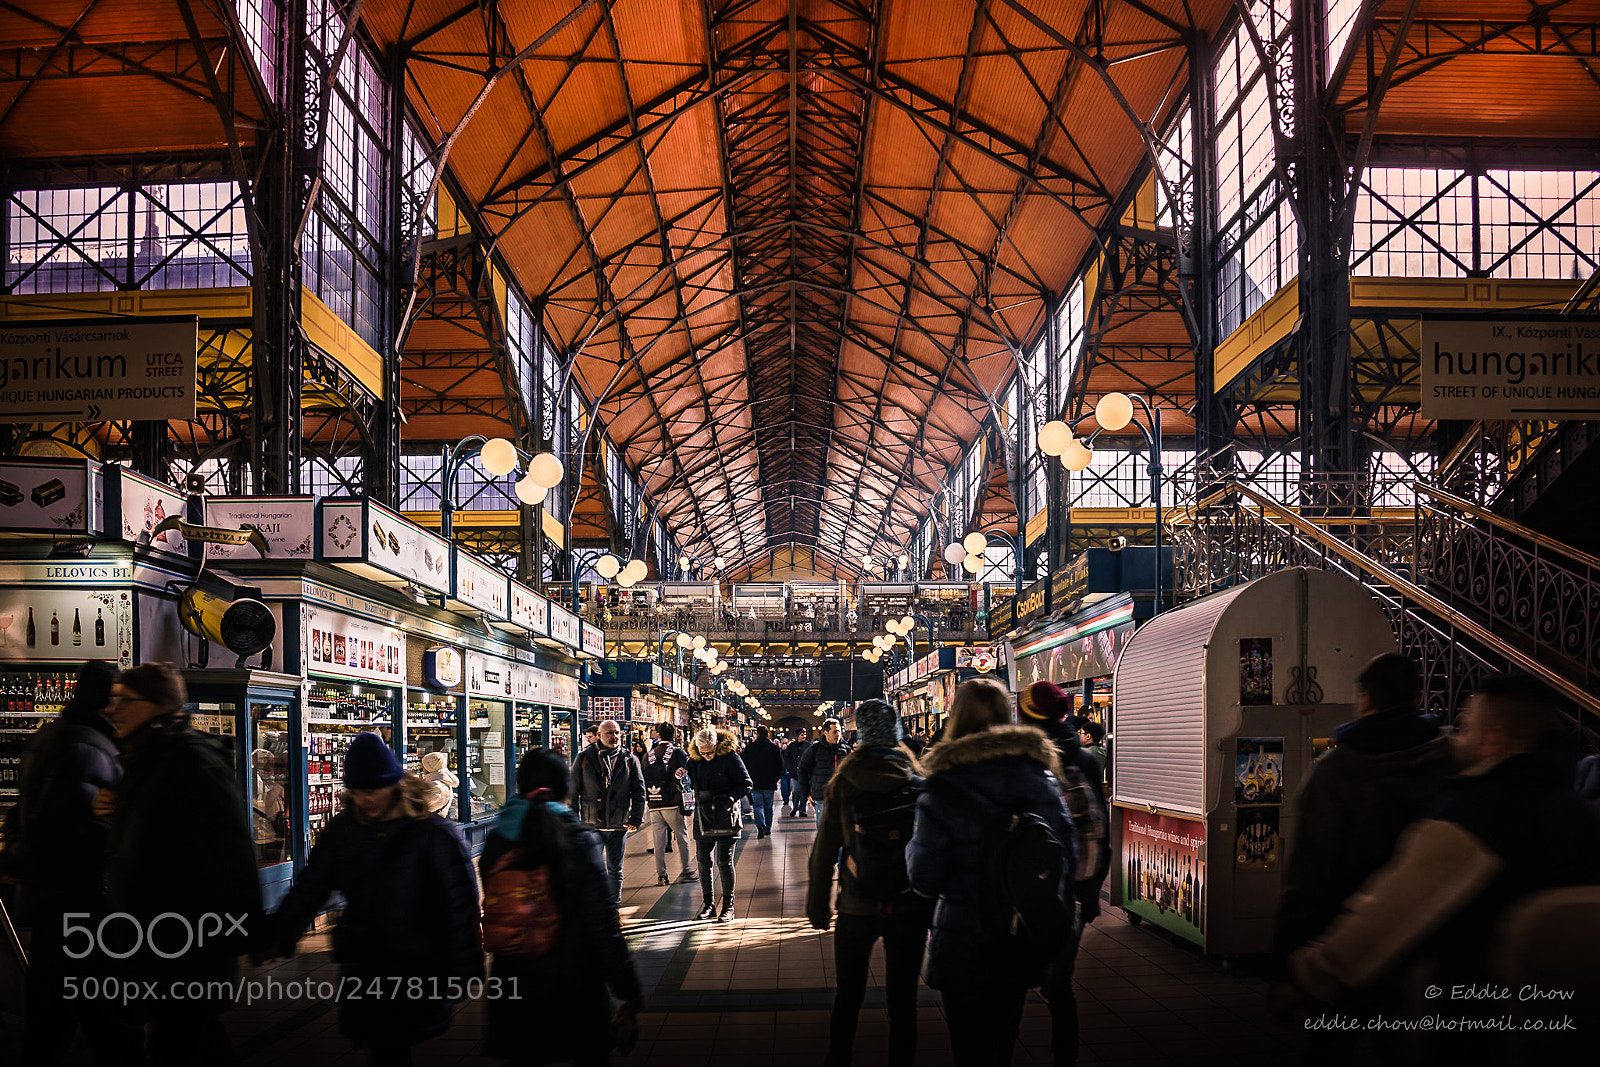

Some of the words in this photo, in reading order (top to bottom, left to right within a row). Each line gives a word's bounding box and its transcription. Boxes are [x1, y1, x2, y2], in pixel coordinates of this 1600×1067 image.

[1, 331, 51, 347] Központi
[54, 329, 130, 343] Vásárcsarnok
[1493, 326, 1512, 339] IX.,
[1517, 326, 1571, 341] Központi
[146, 353, 183, 366] UTCA
[1434, 342, 1600, 384] hungarik
[146, 366, 184, 377] STREET
[37, 388, 113, 402] HUNGARIAN
[118, 386, 185, 399] PRODUCTS
[1433, 386, 1477, 398] STREET
[1481, 386, 1499, 398] OF
[1503, 386, 1552, 400] UNIQUE
[260, 512, 292, 520] Hungarian
[46, 567, 108, 578] LELOVICS
[113, 567, 131, 578] BT.
[1128, 820, 1147, 835] Traditional
[1147, 824, 1168, 842] Hungarian
[1168, 831, 1180, 844] wines
[1180, 833, 1190, 847] and
